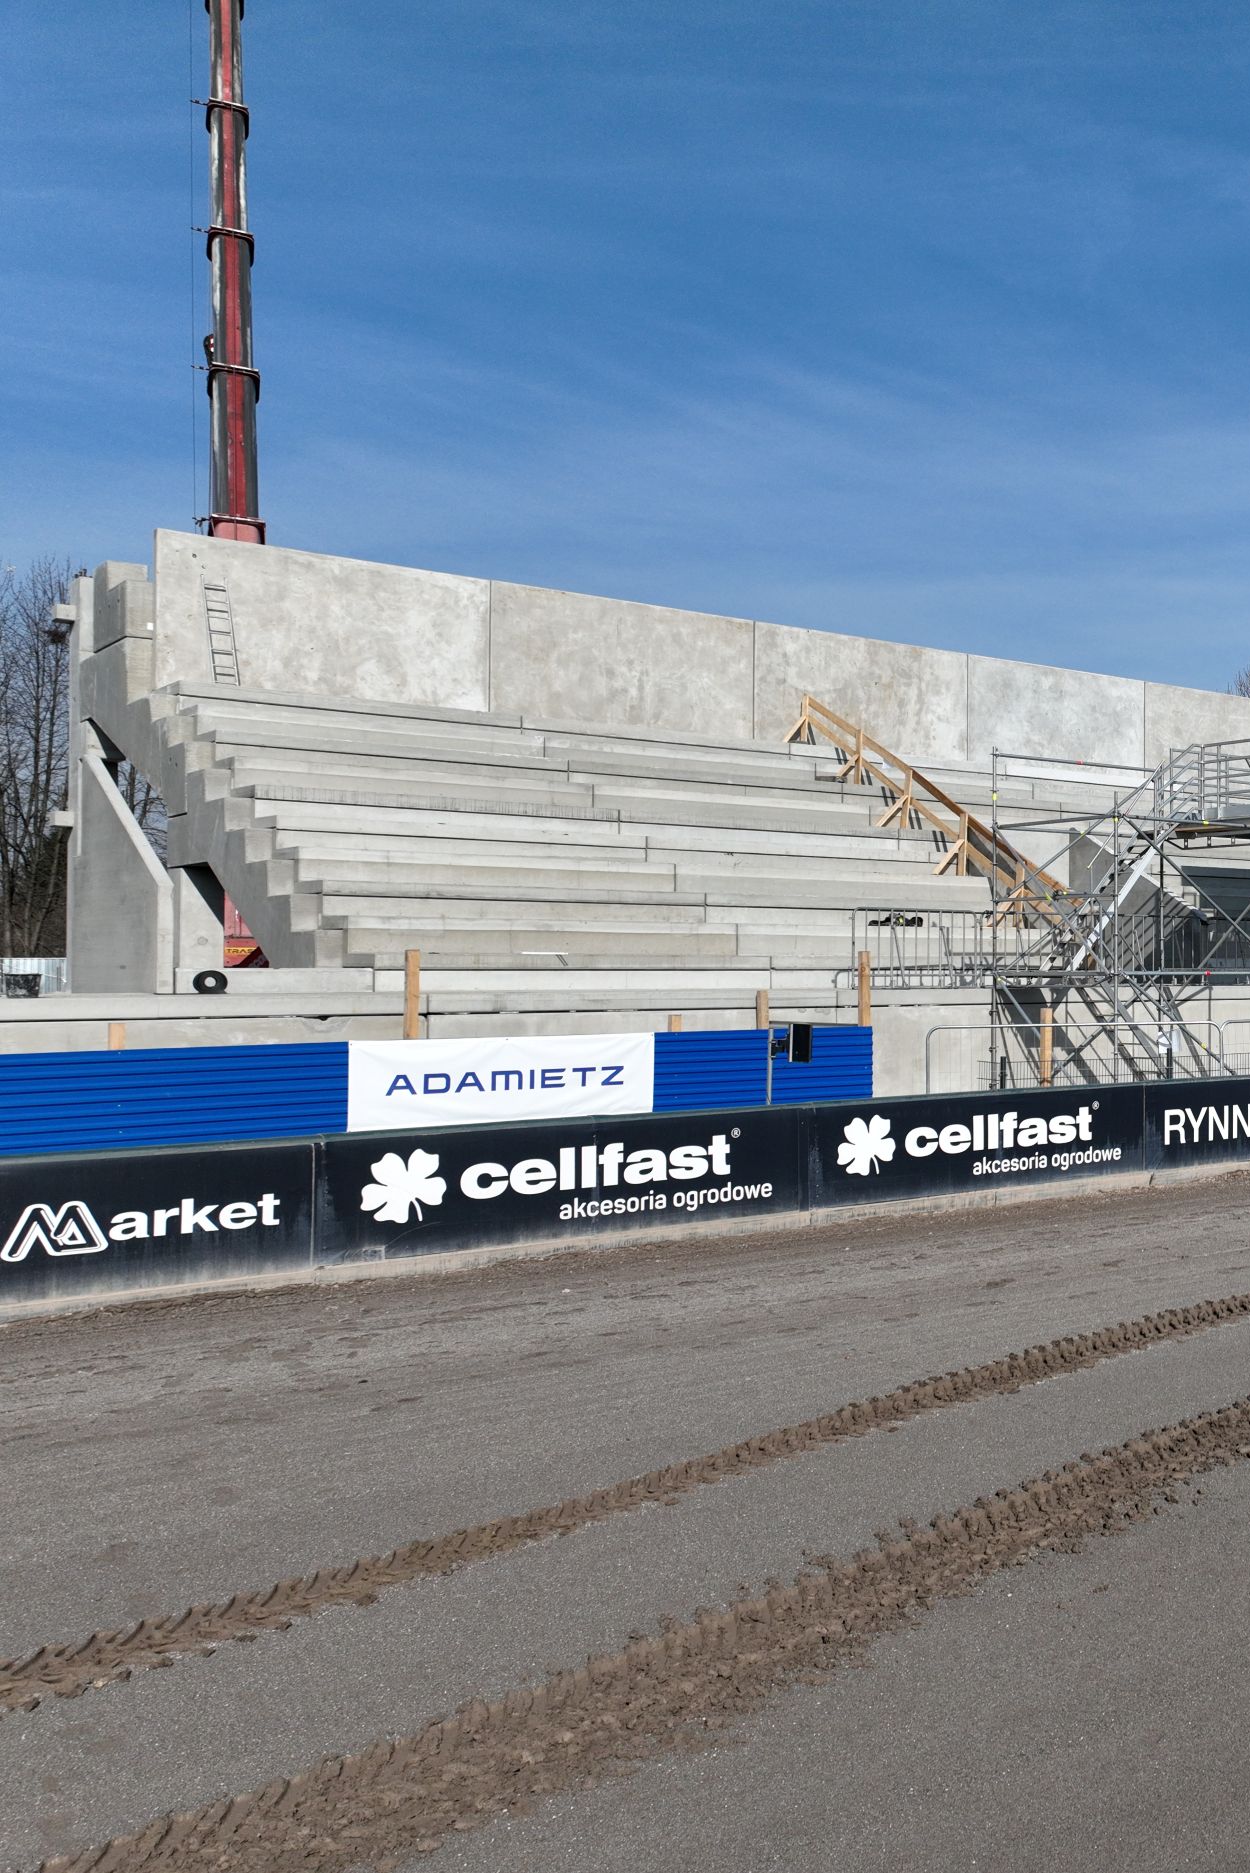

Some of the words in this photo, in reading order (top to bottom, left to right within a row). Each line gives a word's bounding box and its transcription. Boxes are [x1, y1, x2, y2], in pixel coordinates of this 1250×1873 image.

[385, 1064, 626, 1097] ADAMIETZ
[904, 1105, 1093, 1158] cellfast
[460, 1133, 732, 1200] cellfast
[972, 1153, 1048, 1176] akcesoria
[1051, 1144, 1122, 1173] ogrodowe
[558, 1189, 668, 1221] akcesoria
[672, 1180, 774, 1214] ogrodowe
